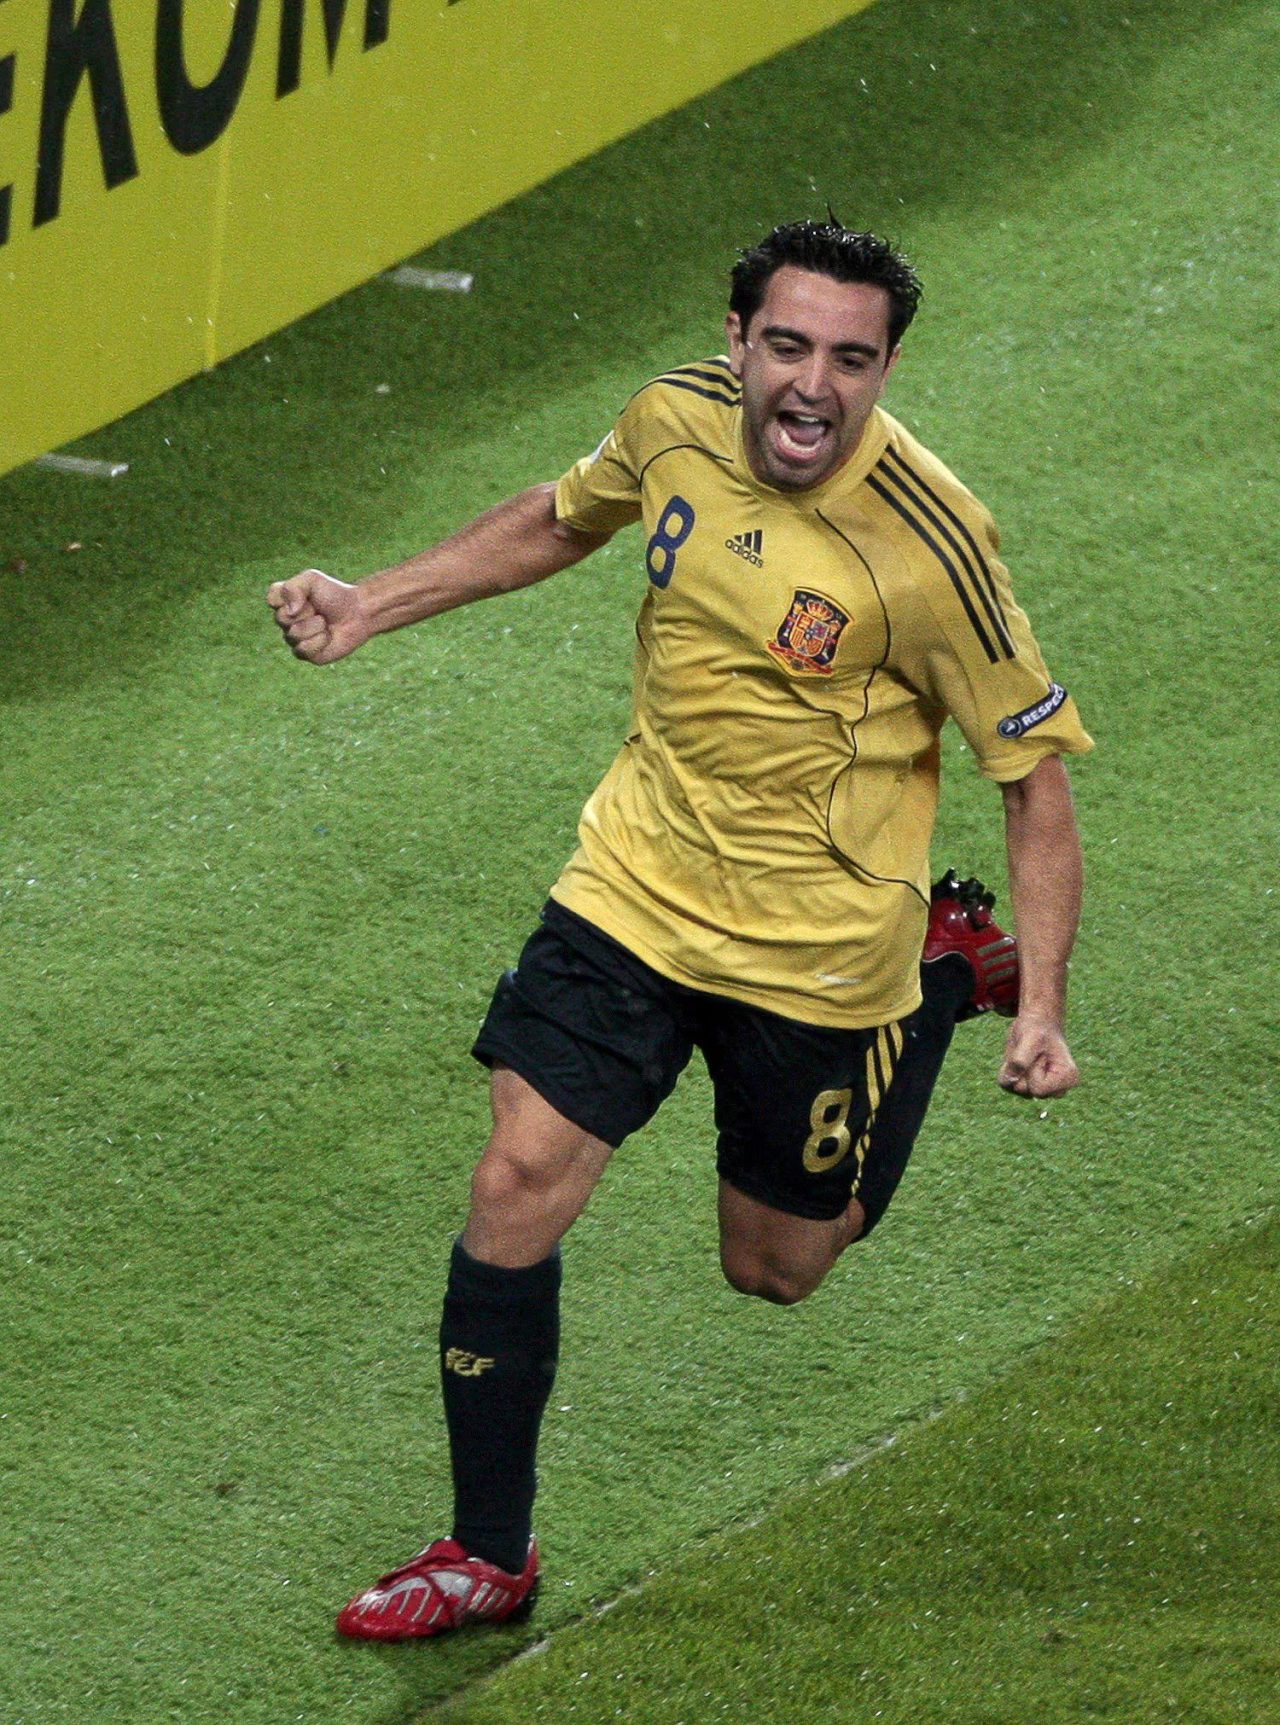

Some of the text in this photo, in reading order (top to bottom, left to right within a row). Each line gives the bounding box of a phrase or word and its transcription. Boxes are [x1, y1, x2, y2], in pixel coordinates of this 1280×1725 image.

[0, 0, 391, 246] KO
[646, 495, 695, 590] 8
[725, 539, 764, 568] adidas
[803, 1090, 851, 1173] 8
